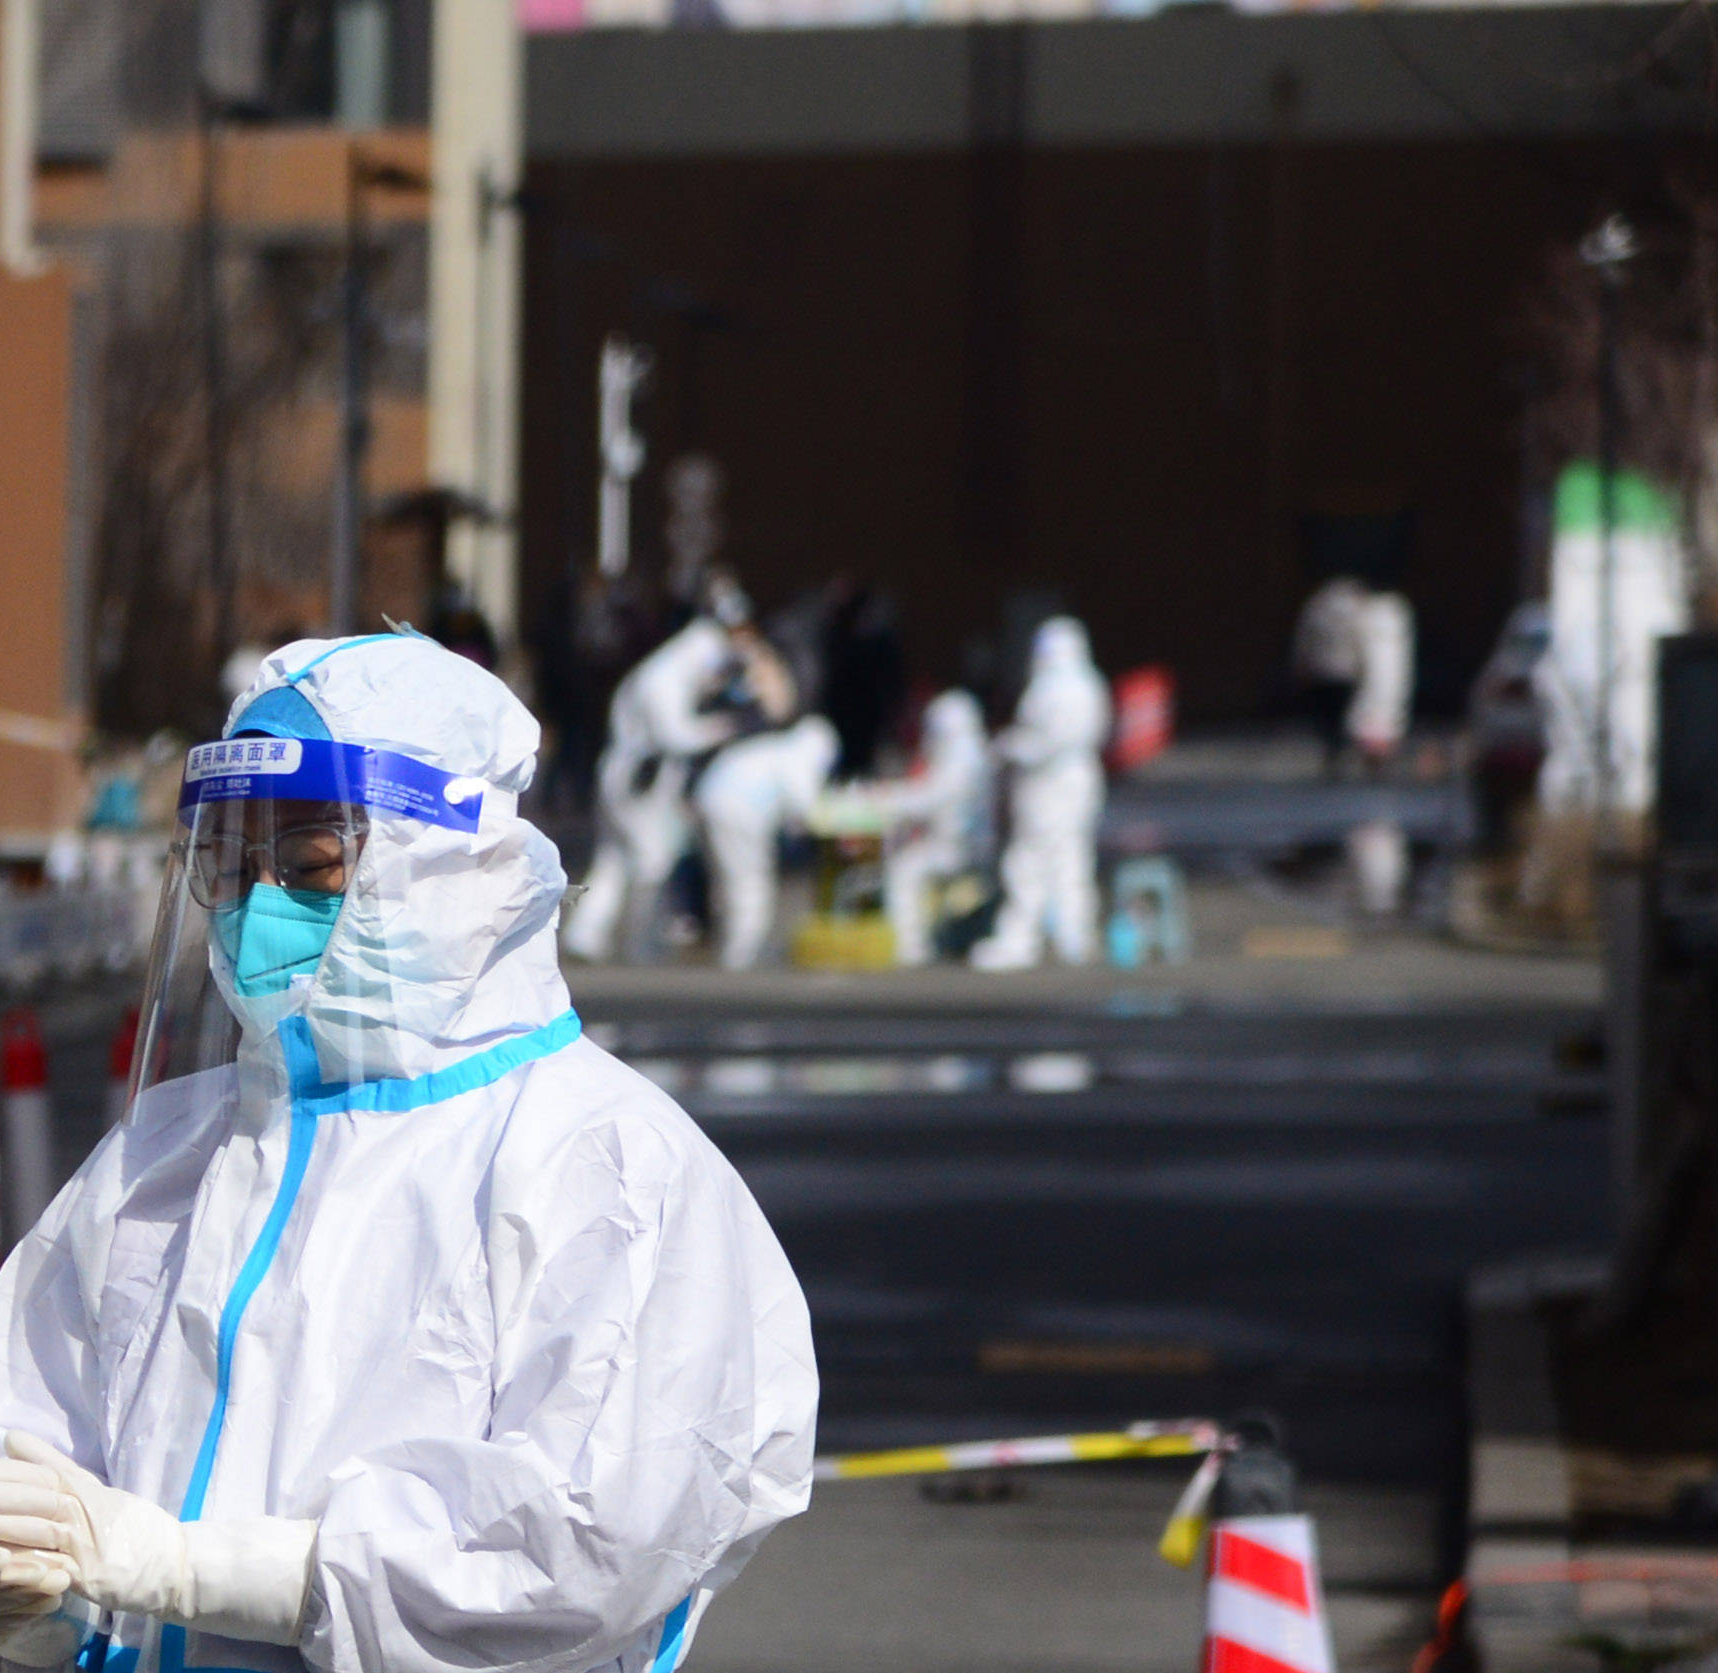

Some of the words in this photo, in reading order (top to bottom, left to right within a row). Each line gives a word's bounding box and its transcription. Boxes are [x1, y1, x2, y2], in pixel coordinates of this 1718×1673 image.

[190, 742, 286, 770] 医用隔离面罩
